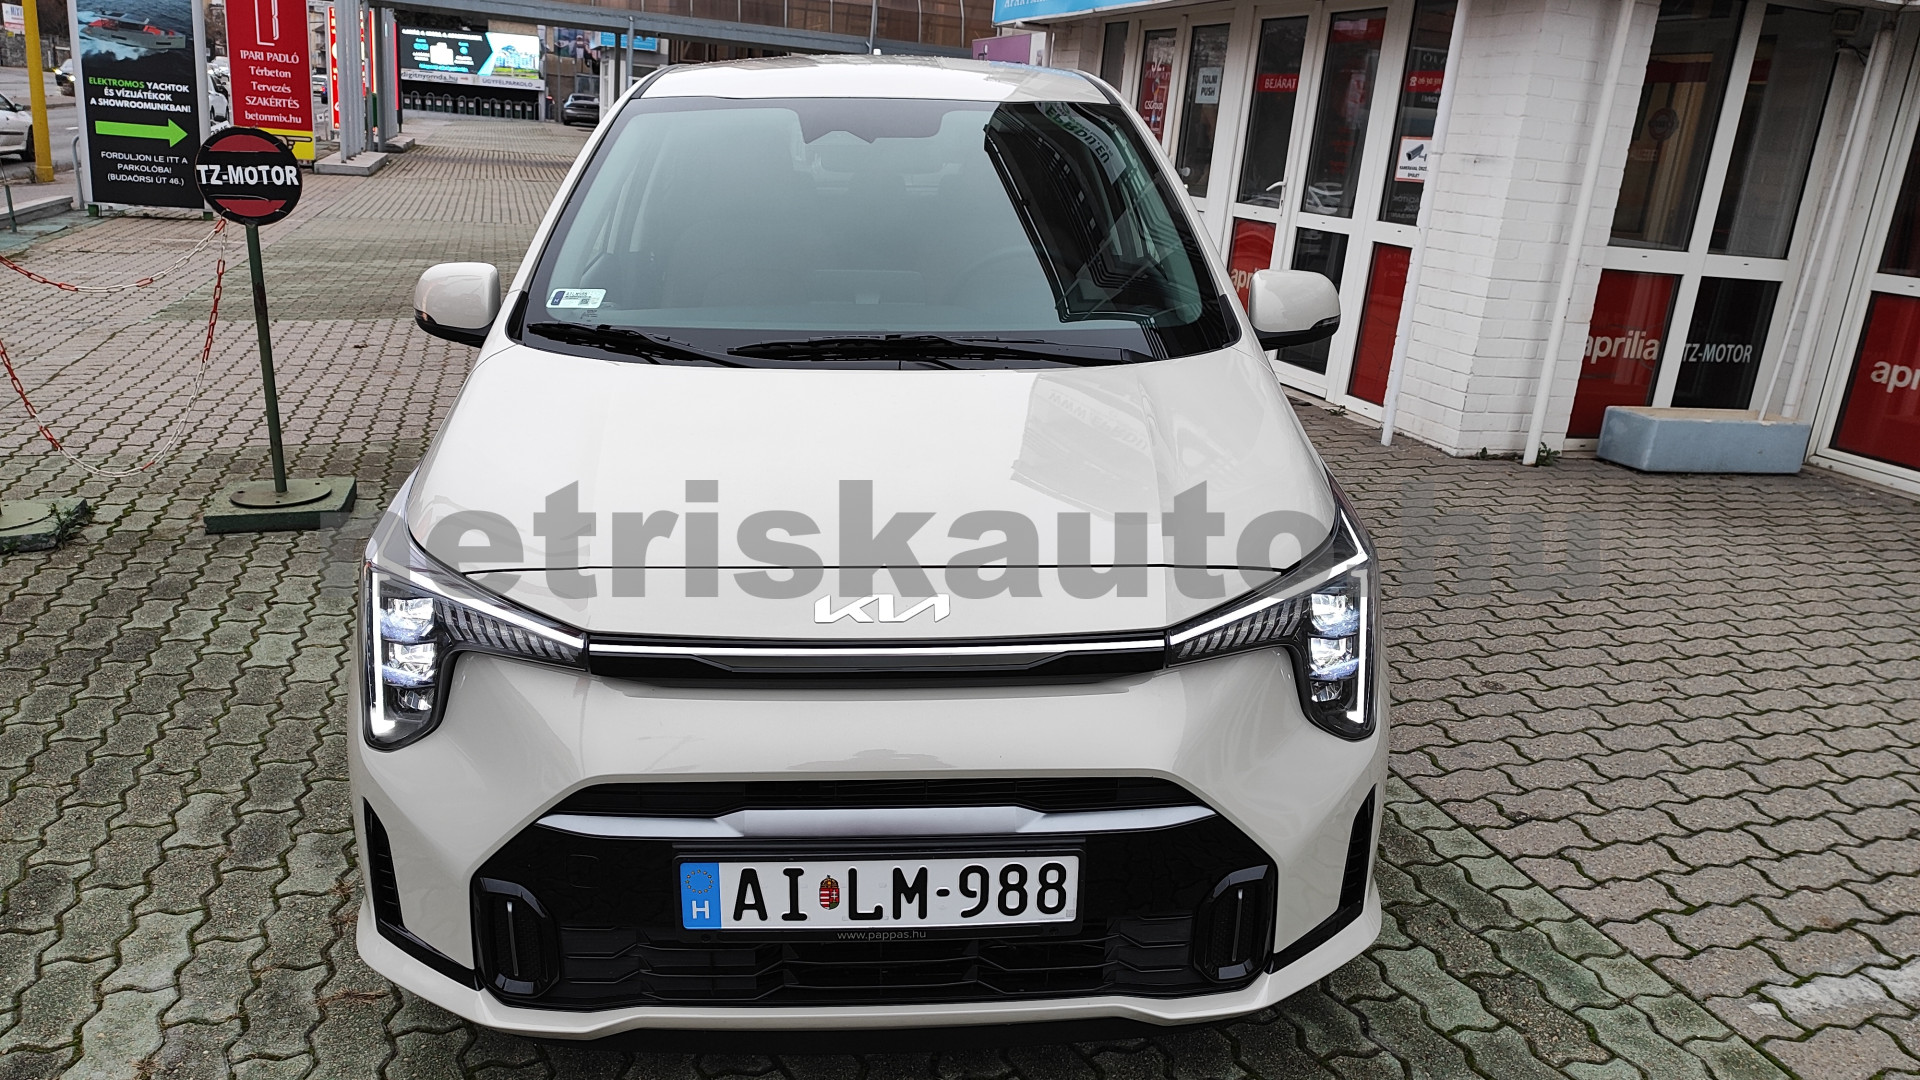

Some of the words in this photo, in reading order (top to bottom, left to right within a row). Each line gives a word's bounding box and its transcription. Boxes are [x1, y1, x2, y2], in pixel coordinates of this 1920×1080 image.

[240, 49, 264, 61] IPARI
[266, 52, 300, 64] PADLÓ
[249, 65, 291, 78] Térbeton
[89, 77, 145, 88] ELEKTROMOS
[146, 81, 190, 93] YACHTOK
[251, 81, 291, 93] Tervezés
[1264, 77, 1297, 89] BEJÁRAT
[104, 86, 114, 96] ÉS
[116, 88, 173, 102] VÍZIJÁTÉKOK
[1201, 87, 1215, 96] PUSH
[90, 97, 97, 105] A
[98, 98, 191, 113] SHOWROOMUNKBAN!
[245, 95, 300, 109] SZAKÉRTÉS
[245, 110, 302, 124] betonmix.hu
[101, 151, 152, 162] FORDULJON
[154, 155, 165, 163] LE
[117, 163, 172, 174] PARKOLÓBA!
[196, 164, 299, 186] TZ-MOTOR
[156, 175, 167, 184] ÚT
[169, 177, 185, 187] 46.)
[1231, 267, 1258, 293] apr
[1585, 330, 1661, 365] aprilia
[1683, 343, 1753, 363] TZ-MOTOR
[814, 593, 951, 624] KIA
[733, 867, 808, 922] AI
[847, 862, 1067, 921] LM-988
[692, 901, 710, 919] H
[837, 929, 927, 941] www.pappas.hu
